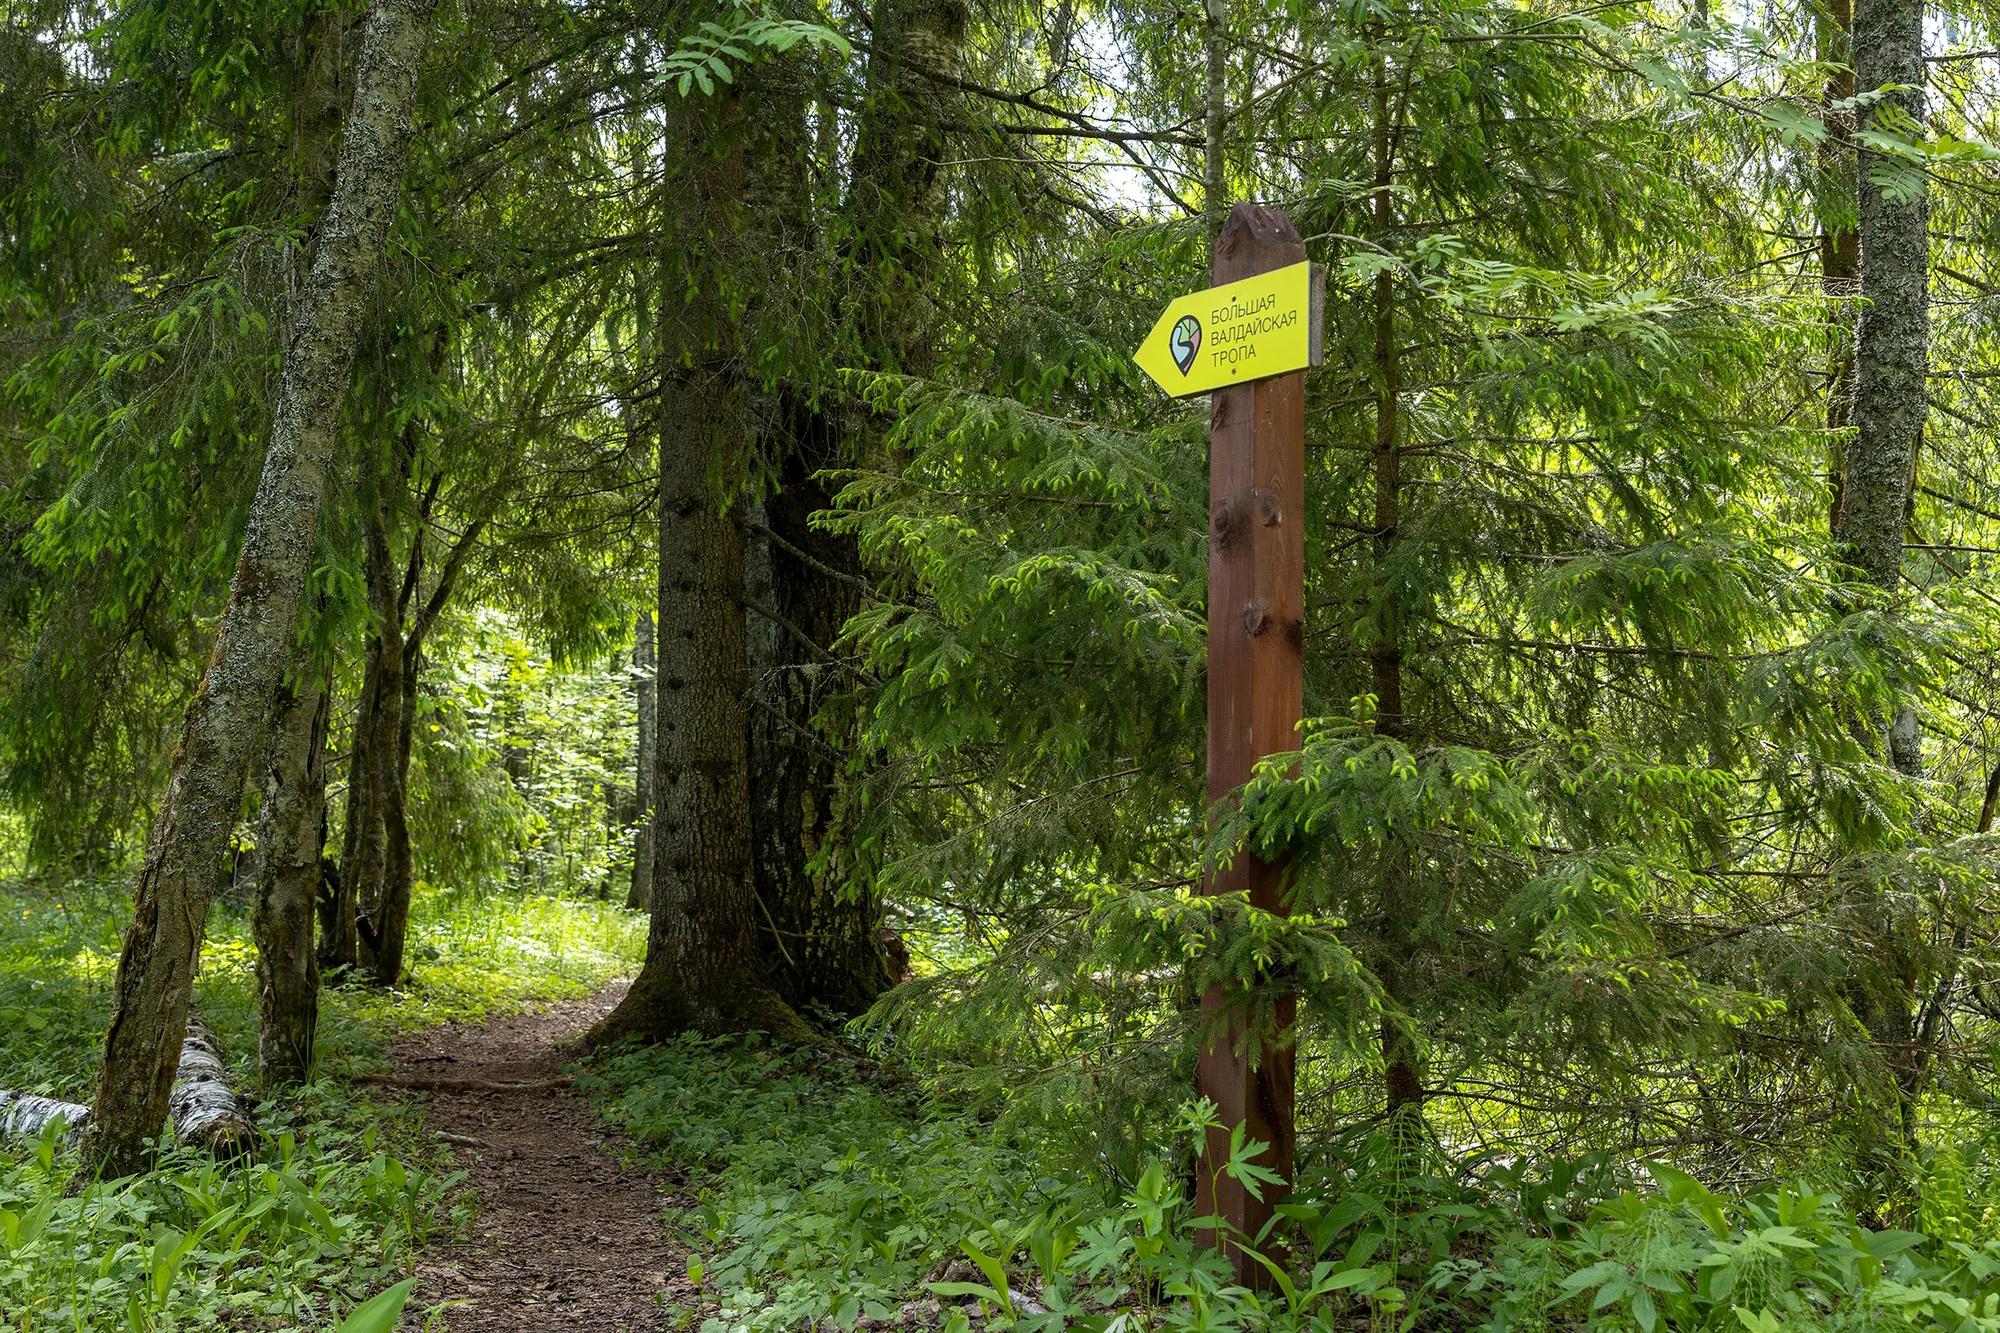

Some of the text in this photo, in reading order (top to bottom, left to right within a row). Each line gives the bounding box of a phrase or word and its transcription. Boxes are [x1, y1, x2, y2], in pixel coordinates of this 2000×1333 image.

[1211, 293, 1275, 325] БОЛЬШАЯ
[1211, 310, 1297, 347] ВАЛДАЙСКАЯ
[1211, 344, 1257, 367] ТРОПА
